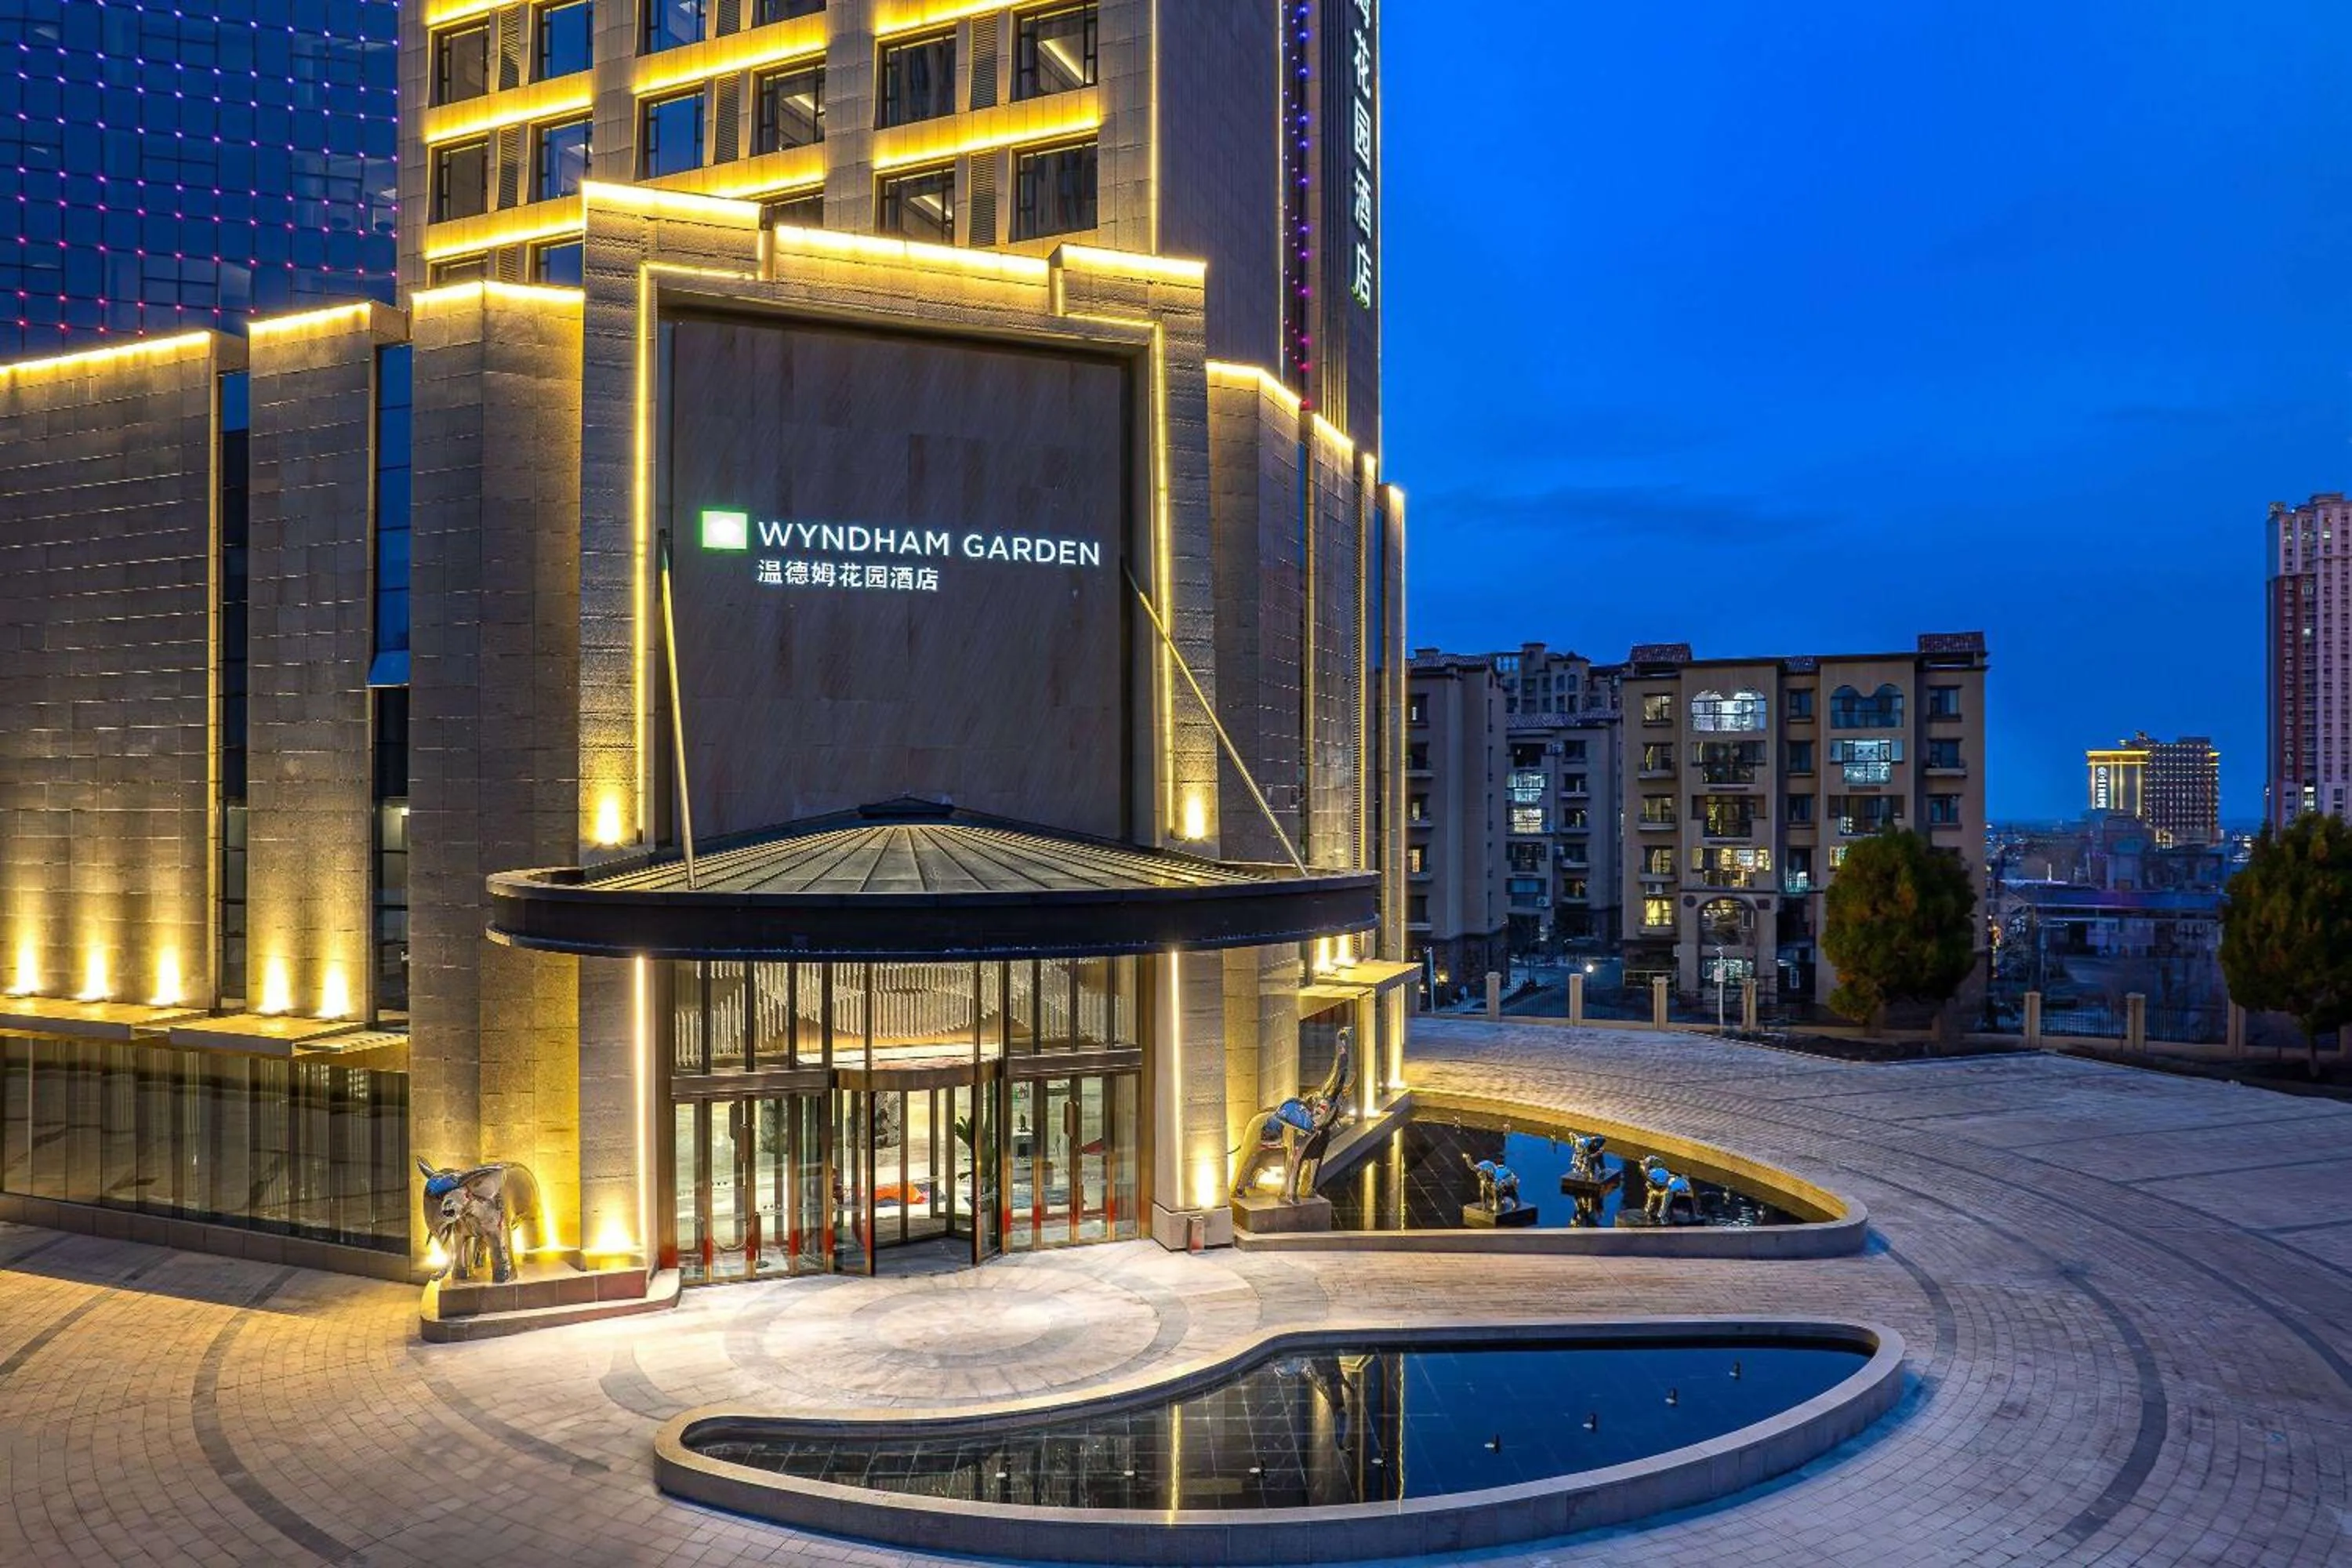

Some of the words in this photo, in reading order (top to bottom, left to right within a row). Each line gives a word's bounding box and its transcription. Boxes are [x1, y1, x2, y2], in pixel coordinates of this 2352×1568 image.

[758, 521, 949, 556] WYNDHAM
[964, 534, 1100, 566] GARDEN
[757, 559, 939, 591] 温德姆花园酒店
